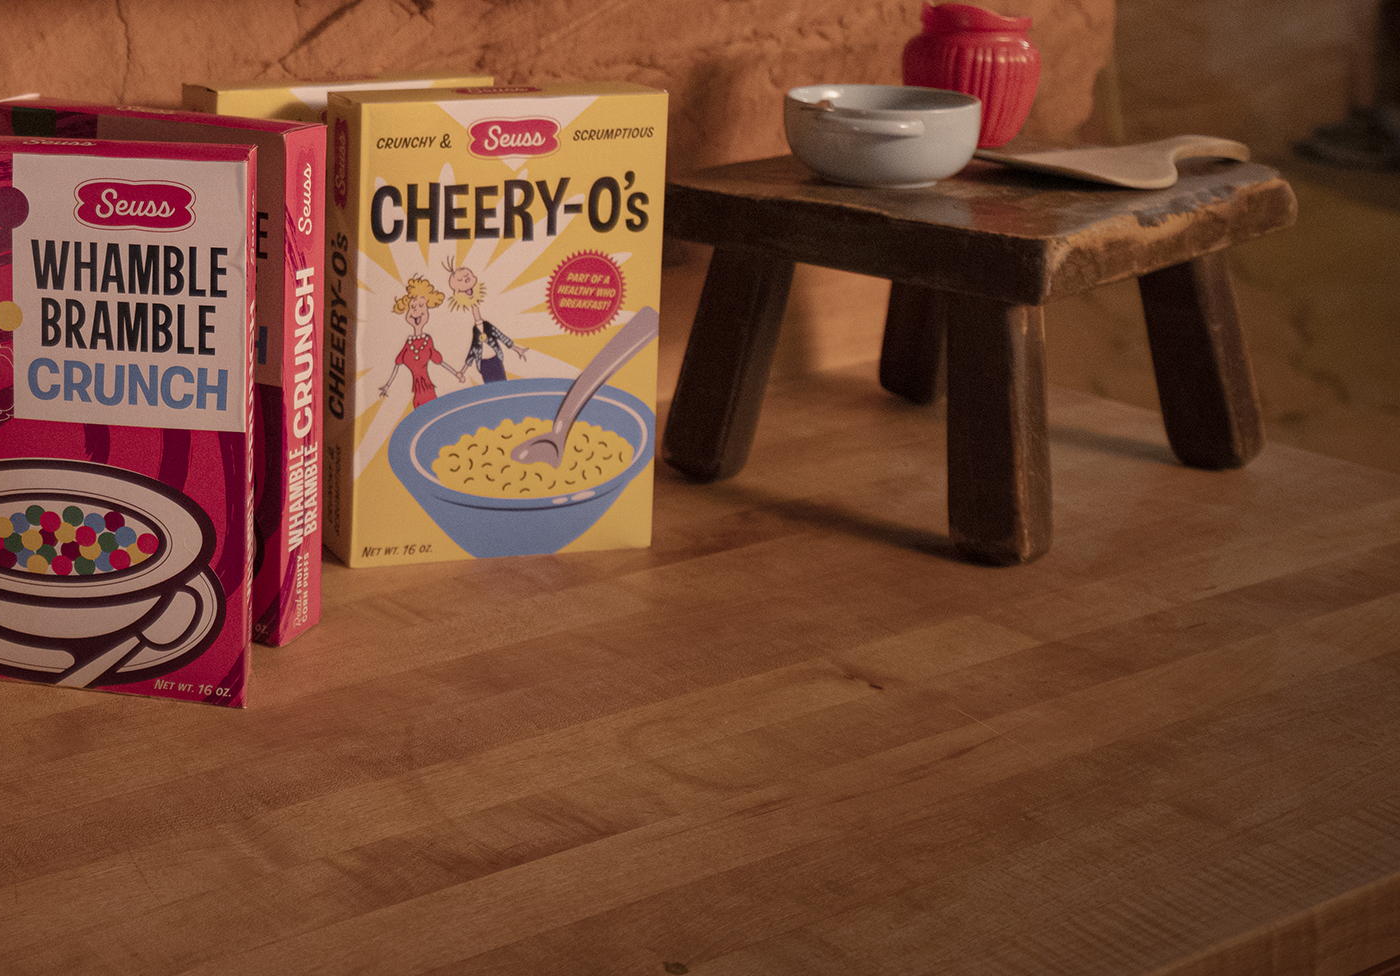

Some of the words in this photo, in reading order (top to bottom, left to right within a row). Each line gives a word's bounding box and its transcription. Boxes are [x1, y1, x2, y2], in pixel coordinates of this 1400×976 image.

[376, 136, 436, 149] CRUNCHY
[440, 133, 452, 149] &
[484, 125, 546, 151] Seuss
[573, 127, 654, 142] SCRUMPTIOUS
[96, 189, 175, 219] Seuss
[298, 162, 312, 235] Seuss
[370, 170, 649, 244] CHEERY-O's
[30, 239, 228, 298] WHAMBLE
[566, 272, 590, 283] PART
[590, 274, 603, 284] OF
[603, 275, 610, 284] A
[557, 285, 596, 296] HEALTHY
[596, 287, 616, 298] WHO
[559, 298, 612, 310] BREAKFAST!
[40, 297, 216, 355] BRAMBLE
[293, 267, 315, 439] CRUNCH
[27, 357, 229, 411] CRUNCH
[288, 445, 304, 553] WHAMBLE
[303, 441, 318, 537] BRAMBLE
[403, 544, 416, 555] 16
[293, 596, 302, 628] Real
[154, 679, 175, 690] NET
[198, 685, 213, 696] 16
